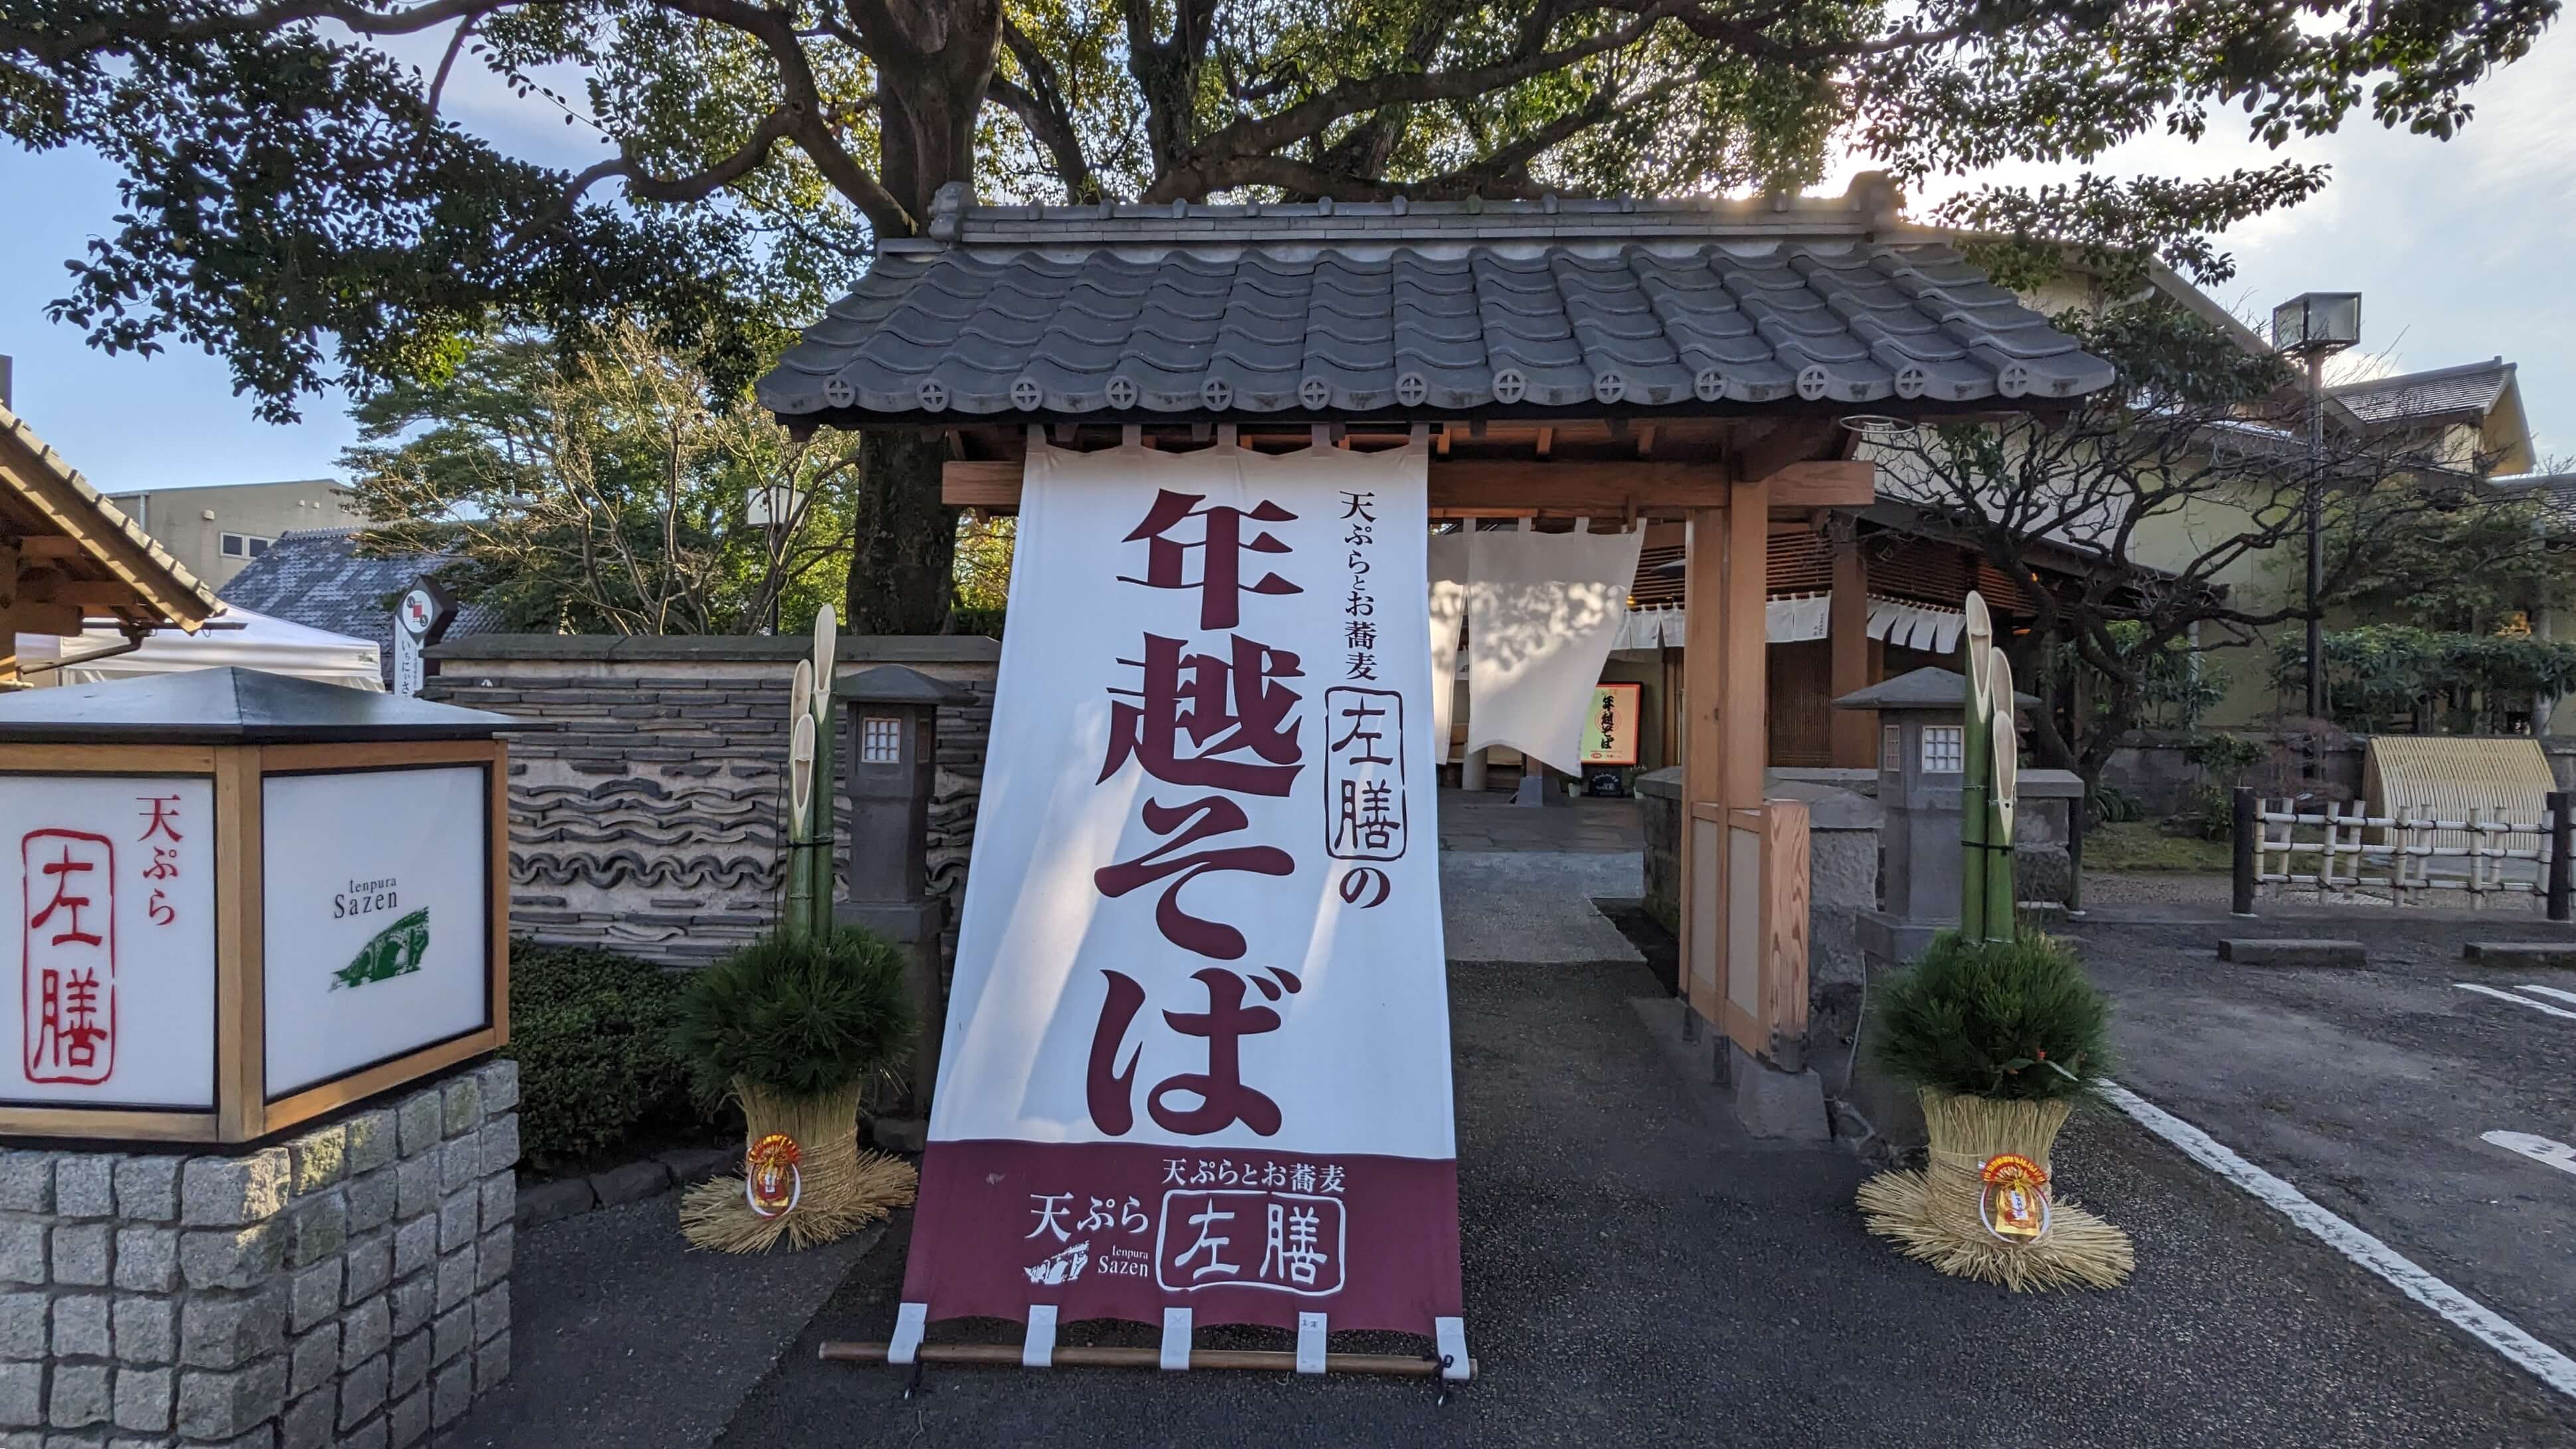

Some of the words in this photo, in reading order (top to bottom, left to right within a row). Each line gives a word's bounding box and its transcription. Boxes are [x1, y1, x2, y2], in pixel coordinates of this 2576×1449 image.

[1339, 490, 1379, 681] 天ぷらとお蕎麦
[1601, 695, 1615, 749] 年越そば
[1087, 488, 1306, 1137] 年越そば
[136, 794, 183, 926] 天ぷら
[349, 877, 397, 894] tenpura
[334, 891, 398, 919] Sazen
[31, 844, 108, 1070] 左膳
[1161, 1157, 1346, 1193] 天ぷらとお蕎麦
[1025, 1191, 1149, 1243] 天ぷら
[1175, 1197, 1328, 1285] 左膳
[1098, 1255, 1149, 1278] Sazen
[1112, 1244, 1149, 1260] tenpura
